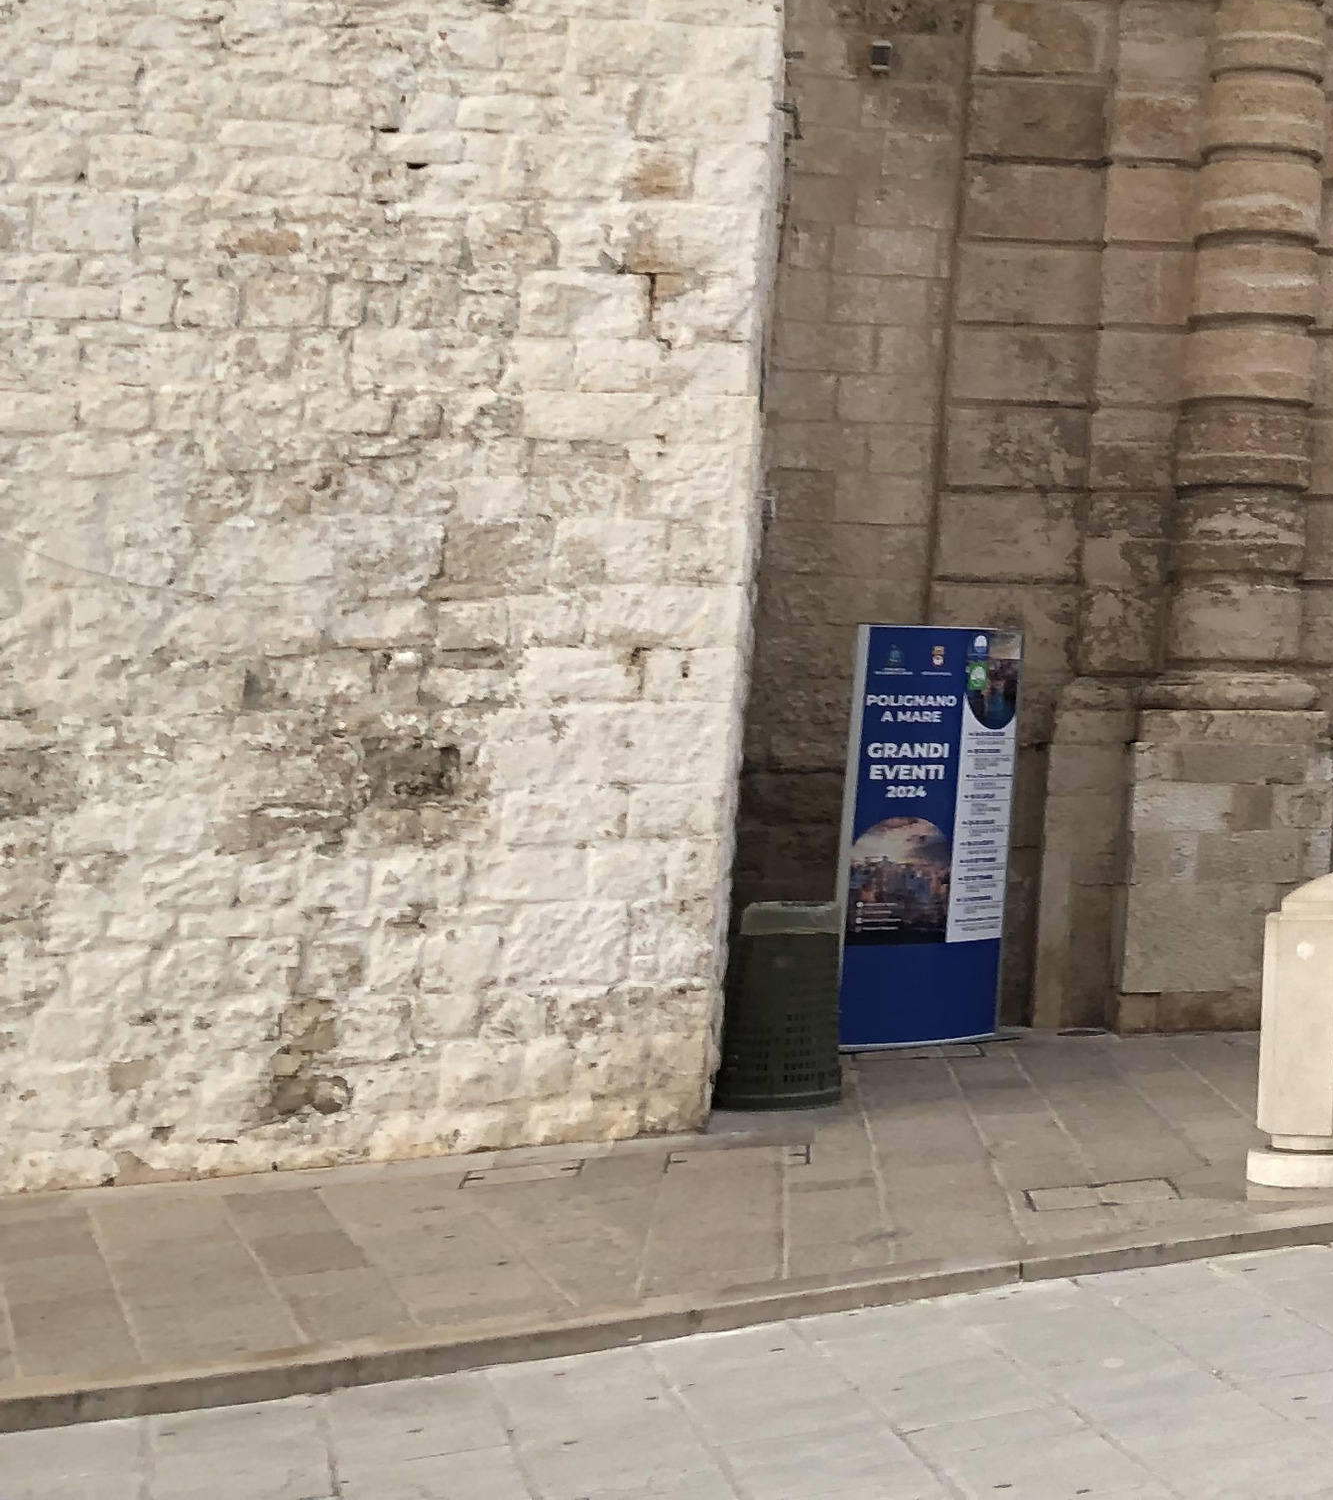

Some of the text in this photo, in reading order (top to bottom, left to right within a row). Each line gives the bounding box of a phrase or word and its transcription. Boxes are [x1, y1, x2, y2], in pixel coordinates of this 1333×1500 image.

[866, 694, 957, 707] POLIGNANO
[880, 710, 942, 723] A MARE
[867, 742, 950, 759] GRANDI
[869, 764, 946, 780] EVENTI
[885, 785, 927, 798] 2024
